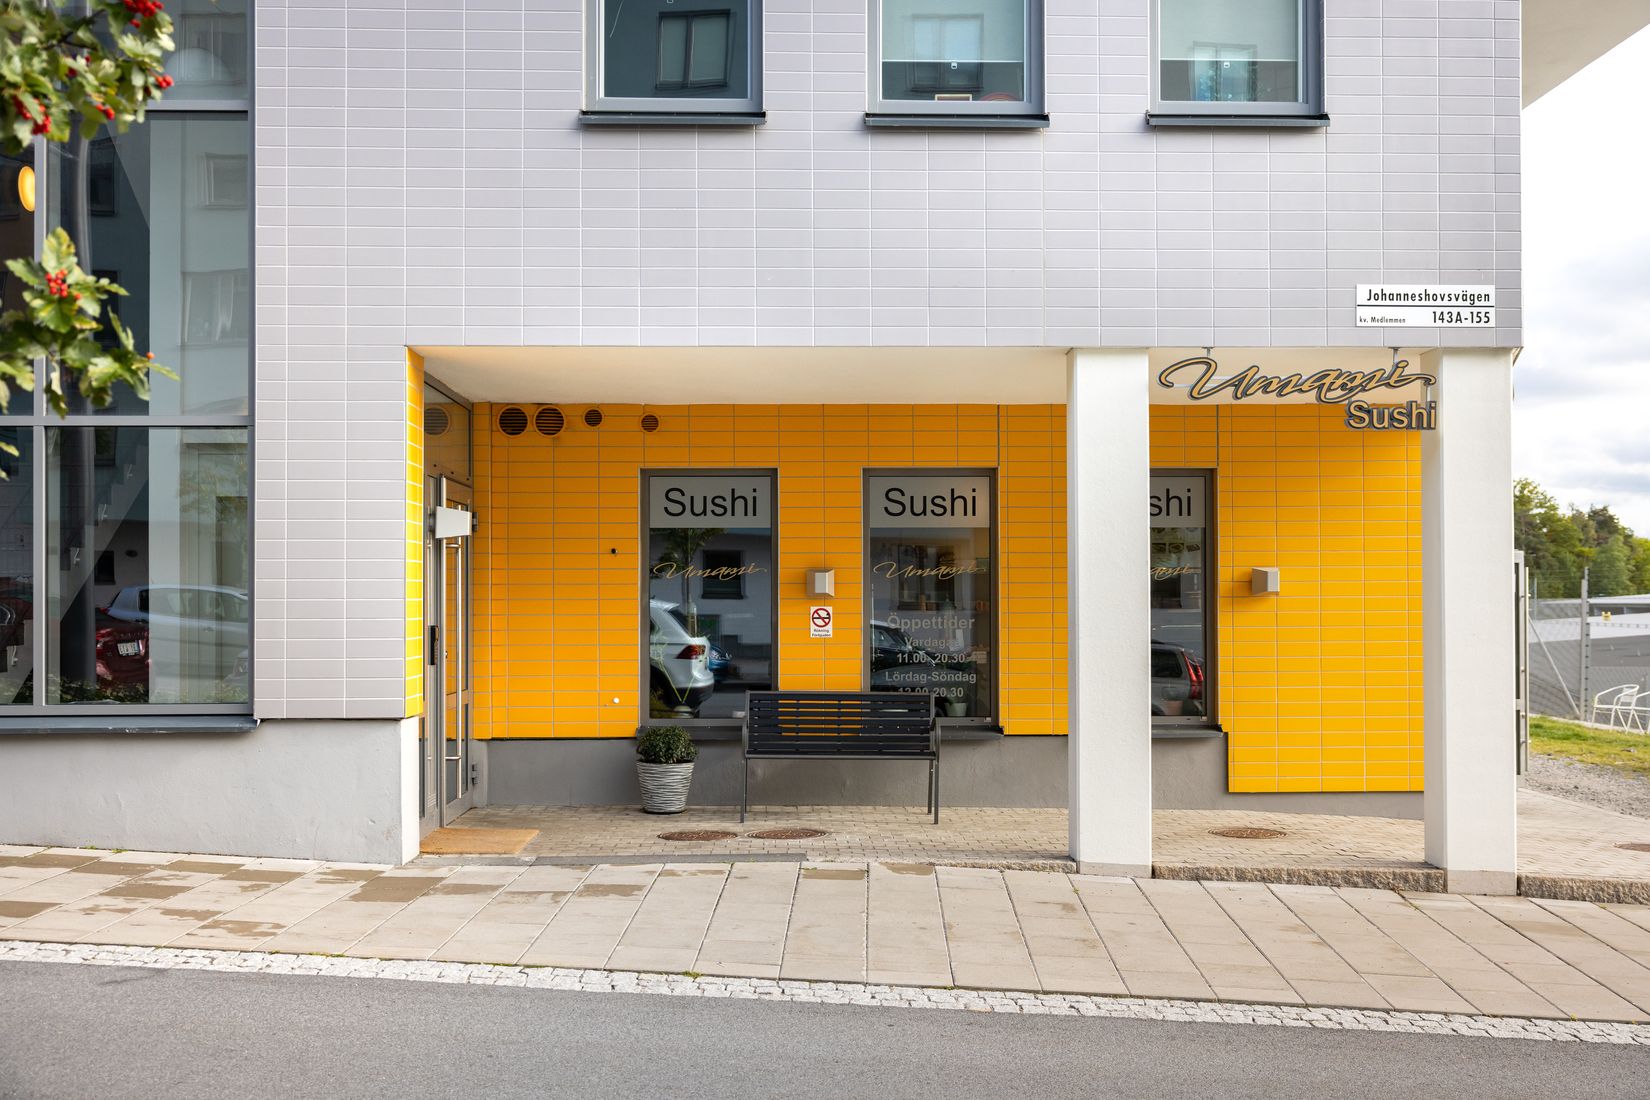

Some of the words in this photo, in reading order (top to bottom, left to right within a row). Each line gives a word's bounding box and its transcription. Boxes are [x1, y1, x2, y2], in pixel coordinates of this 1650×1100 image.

[1366, 288, 1491, 306] Johanneshovsvägen
[1359, 315, 1369, 323] kv.
[1370, 316, 1406, 324] Medlemmen
[1432, 311, 1490, 324] 143A-155
[1158, 356, 1437, 404] Umami
[1346, 400, 1437, 430] Sushi
[664, 487, 757, 517] Sushi
[883, 487, 976, 517] Sushi
[1150, 487, 1192, 517] shi
[653, 562, 767, 581] Umami
[873, 561, 986, 580] Umami
[887, 612, 975, 632] Öppettider
[885, 671, 977, 684] Lördag-Söndag
